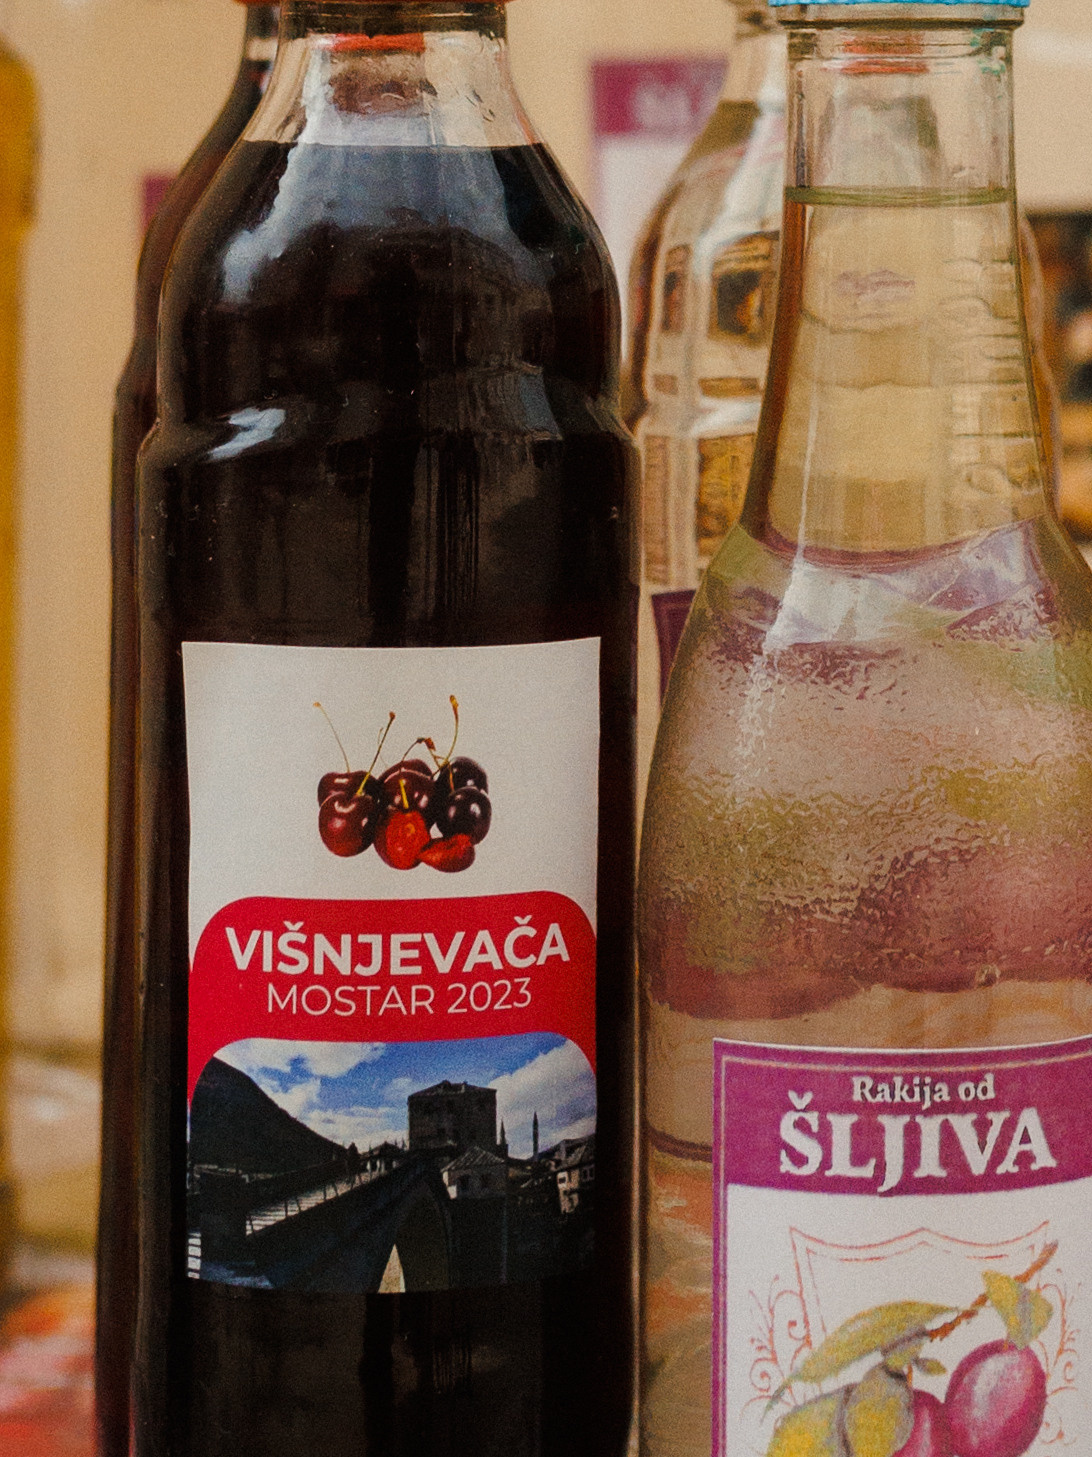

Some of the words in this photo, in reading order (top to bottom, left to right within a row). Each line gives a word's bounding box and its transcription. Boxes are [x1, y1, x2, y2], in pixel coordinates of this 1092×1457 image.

[225, 915, 571, 977] VIŠNJEVAČA
[267, 982, 435, 1017] MOSTAR
[447, 977, 532, 1014] 2023
[851, 1075, 950, 1110] Rakija
[957, 1072, 996, 1102] od
[779, 1090, 1058, 1193] ŠLJIVA
